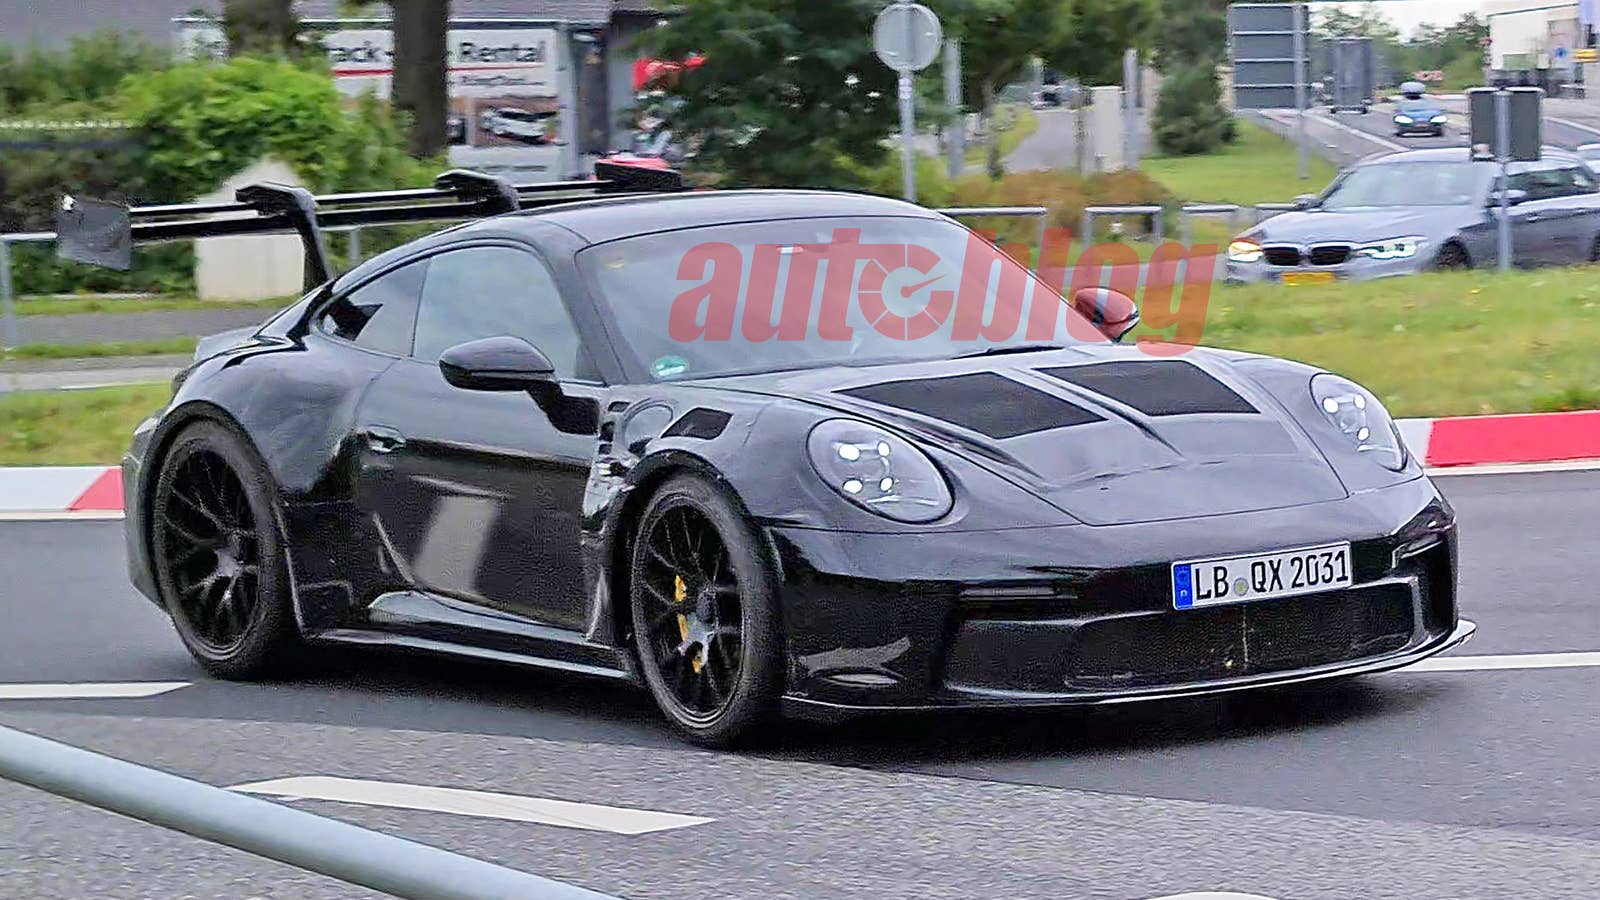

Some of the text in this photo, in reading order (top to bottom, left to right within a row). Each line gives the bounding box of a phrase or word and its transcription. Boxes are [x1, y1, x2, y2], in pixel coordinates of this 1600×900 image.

[461, 41, 545, 62] Rental
[1195, 566, 1230, 600] LB
[1251, 559, 1284, 593] QX
[1290, 550, 1349, 589] 2031
